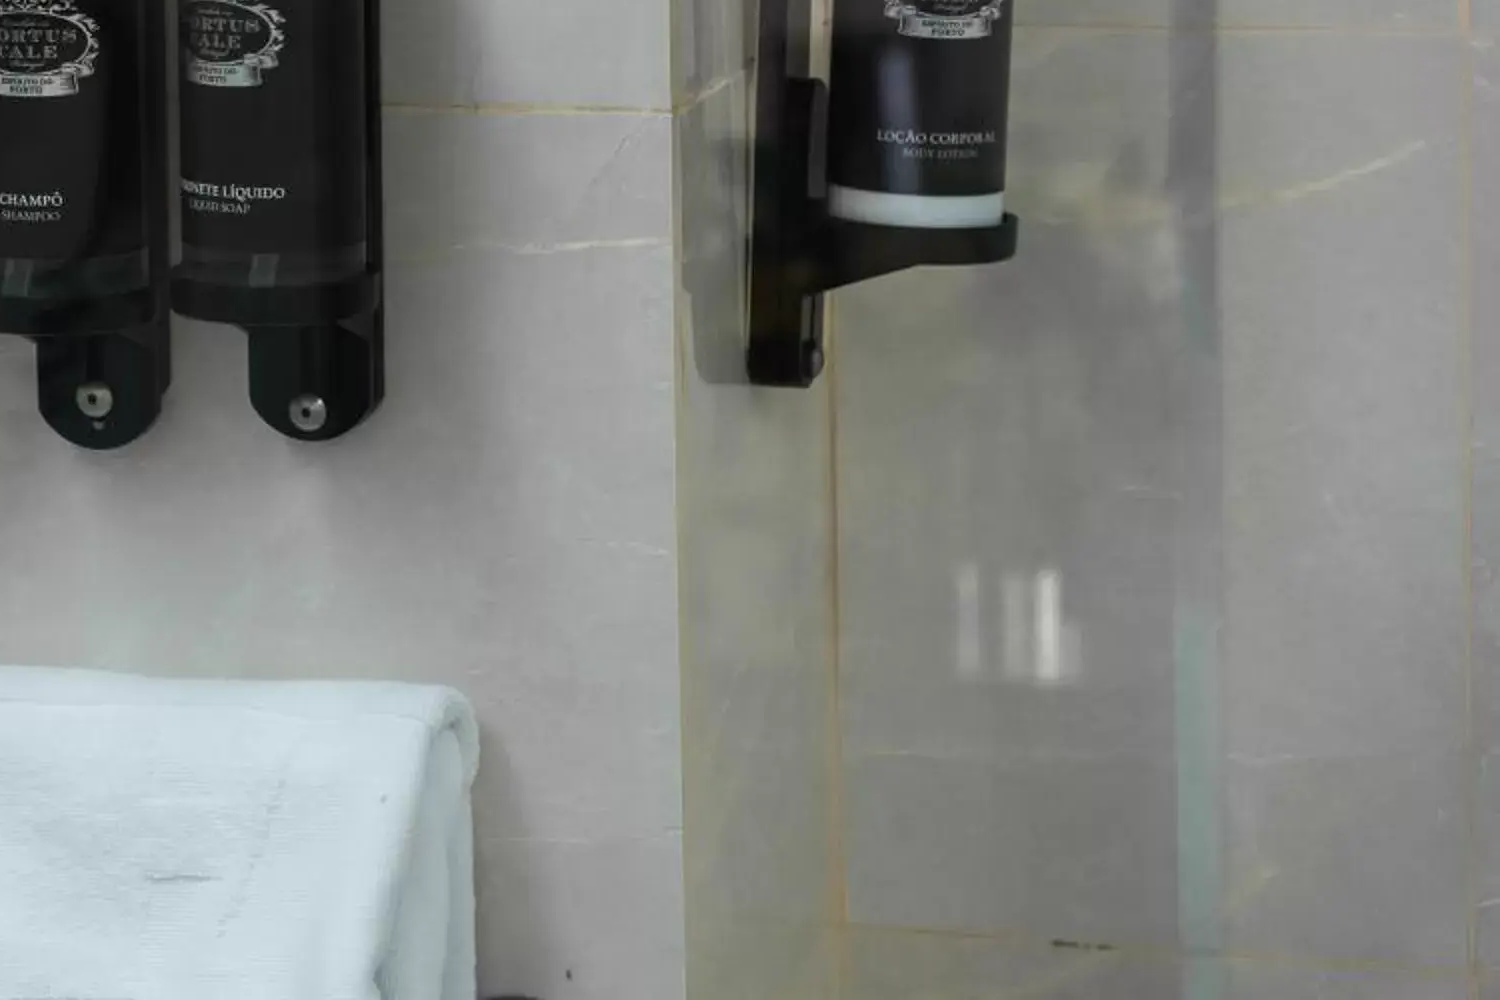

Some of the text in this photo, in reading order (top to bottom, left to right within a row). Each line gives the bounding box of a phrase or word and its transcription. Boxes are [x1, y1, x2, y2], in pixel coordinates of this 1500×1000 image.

[222, 183, 286, 202] LÍQUIDO
[220, 201, 252, 214] SOAP
[0, 209, 62, 221] SHAMPOO
